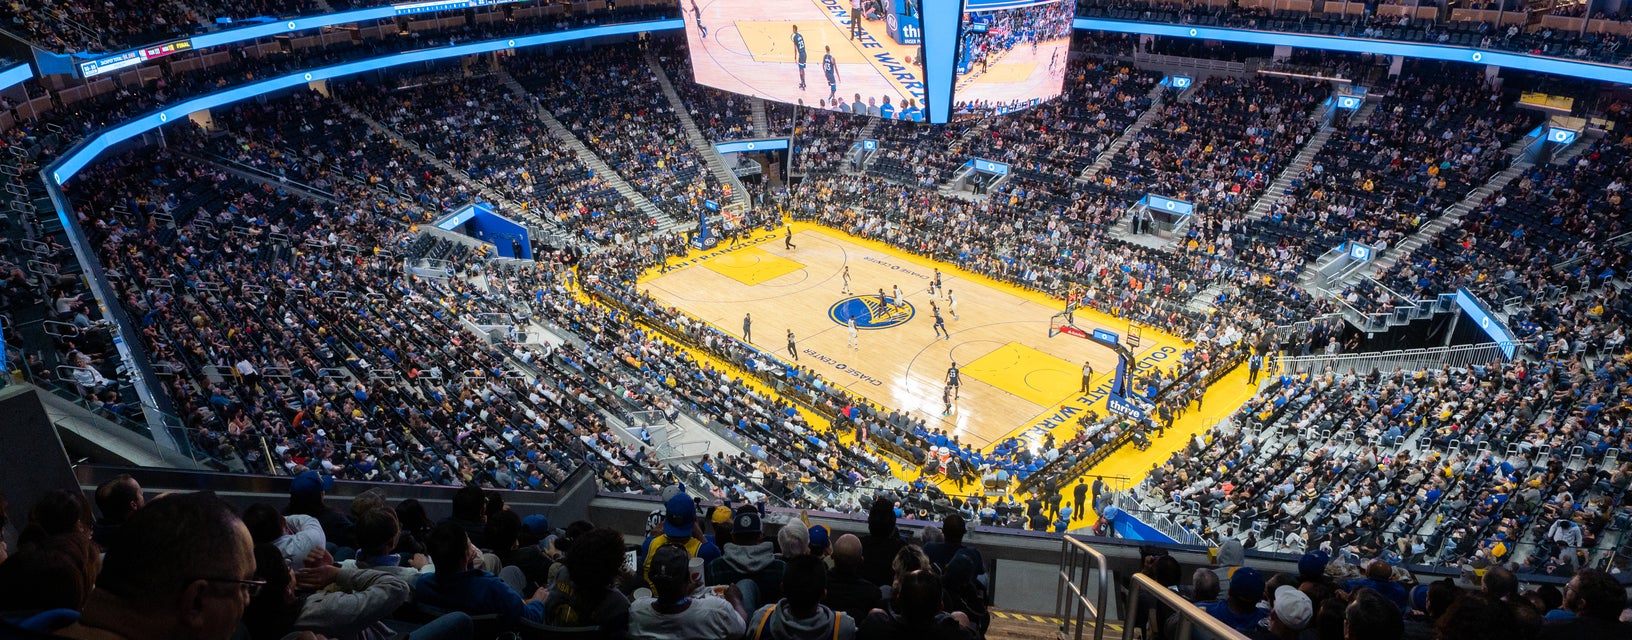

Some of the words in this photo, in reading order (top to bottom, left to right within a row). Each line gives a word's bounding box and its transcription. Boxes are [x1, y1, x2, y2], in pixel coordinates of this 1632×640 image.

[690, 234, 777, 264] FRANCISCO
[803, 348, 837, 365] CENTER
[844, 367, 883, 387] CHASE
[1109, 400, 1141, 418] thrive
